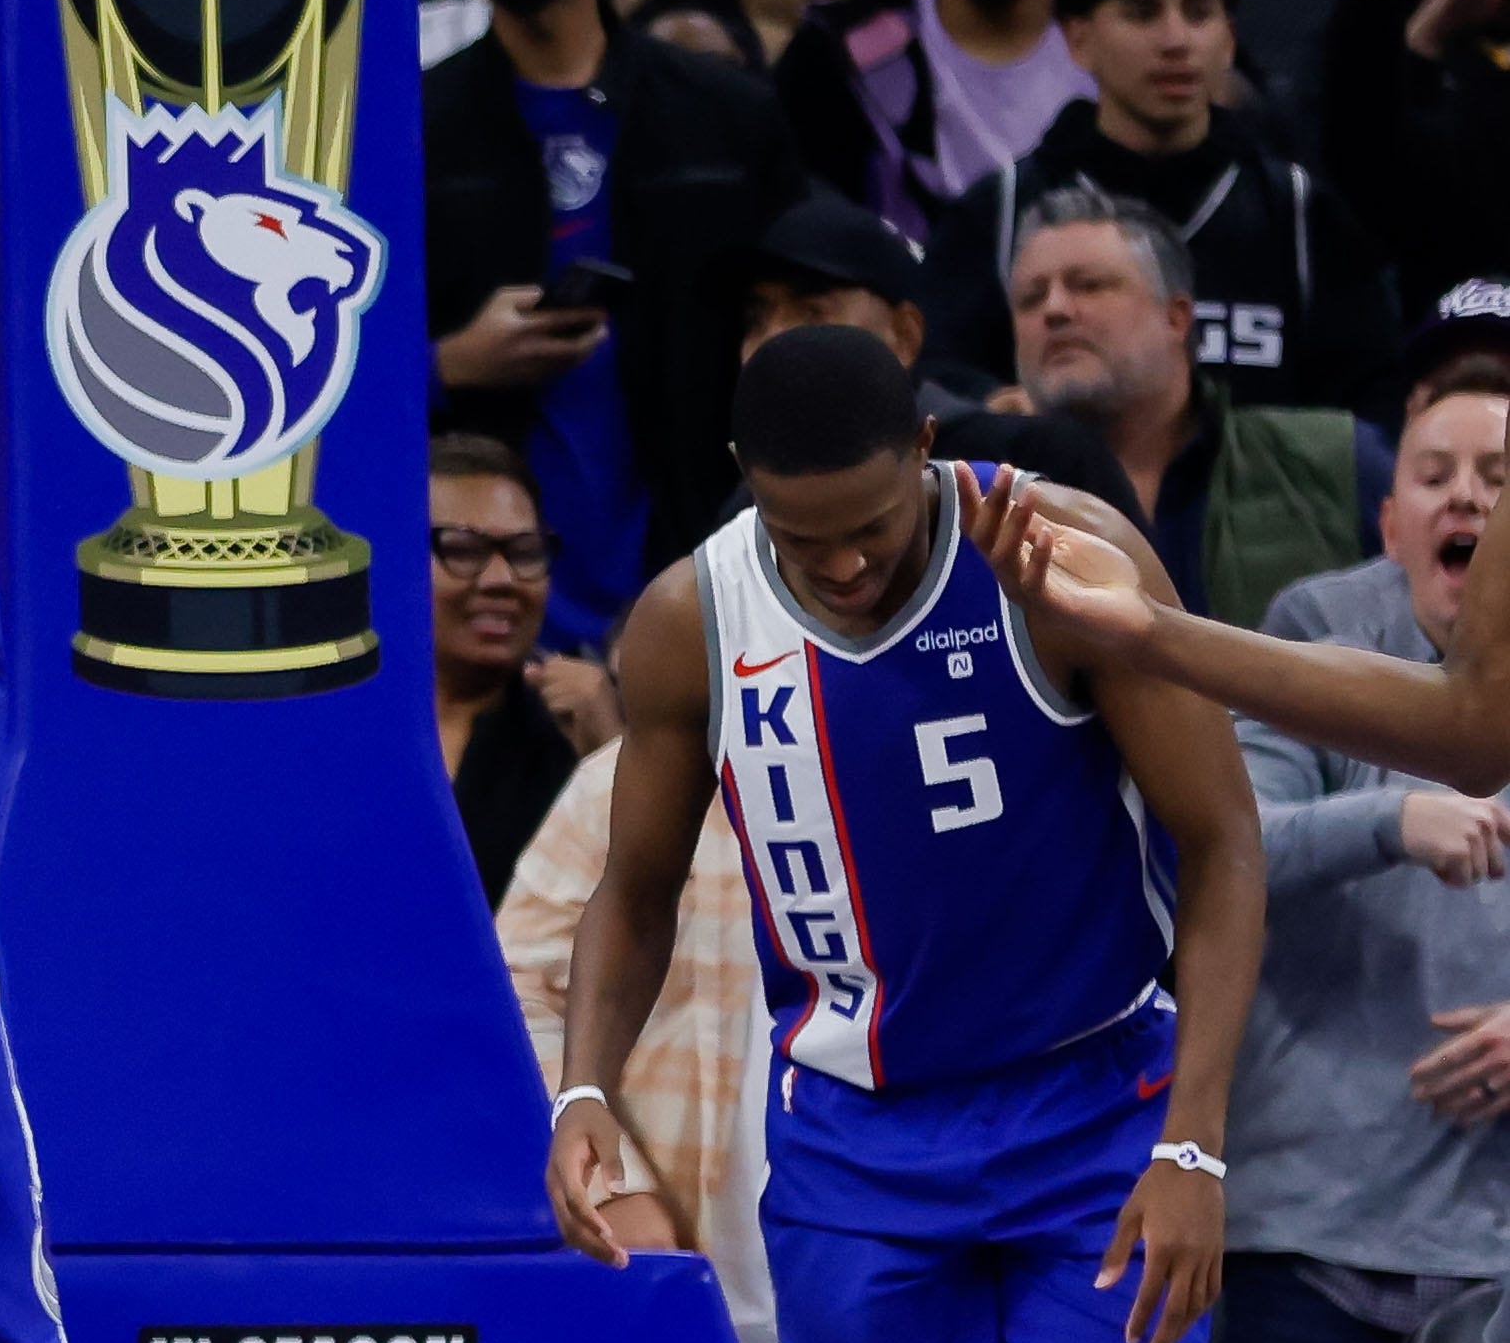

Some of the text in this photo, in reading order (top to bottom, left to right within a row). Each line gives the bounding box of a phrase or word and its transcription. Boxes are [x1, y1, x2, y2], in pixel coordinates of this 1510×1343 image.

[916, 620, 999, 652] dialpad
[913, 713, 1004, 834] 5
[740, 686, 866, 1021] KINGS
